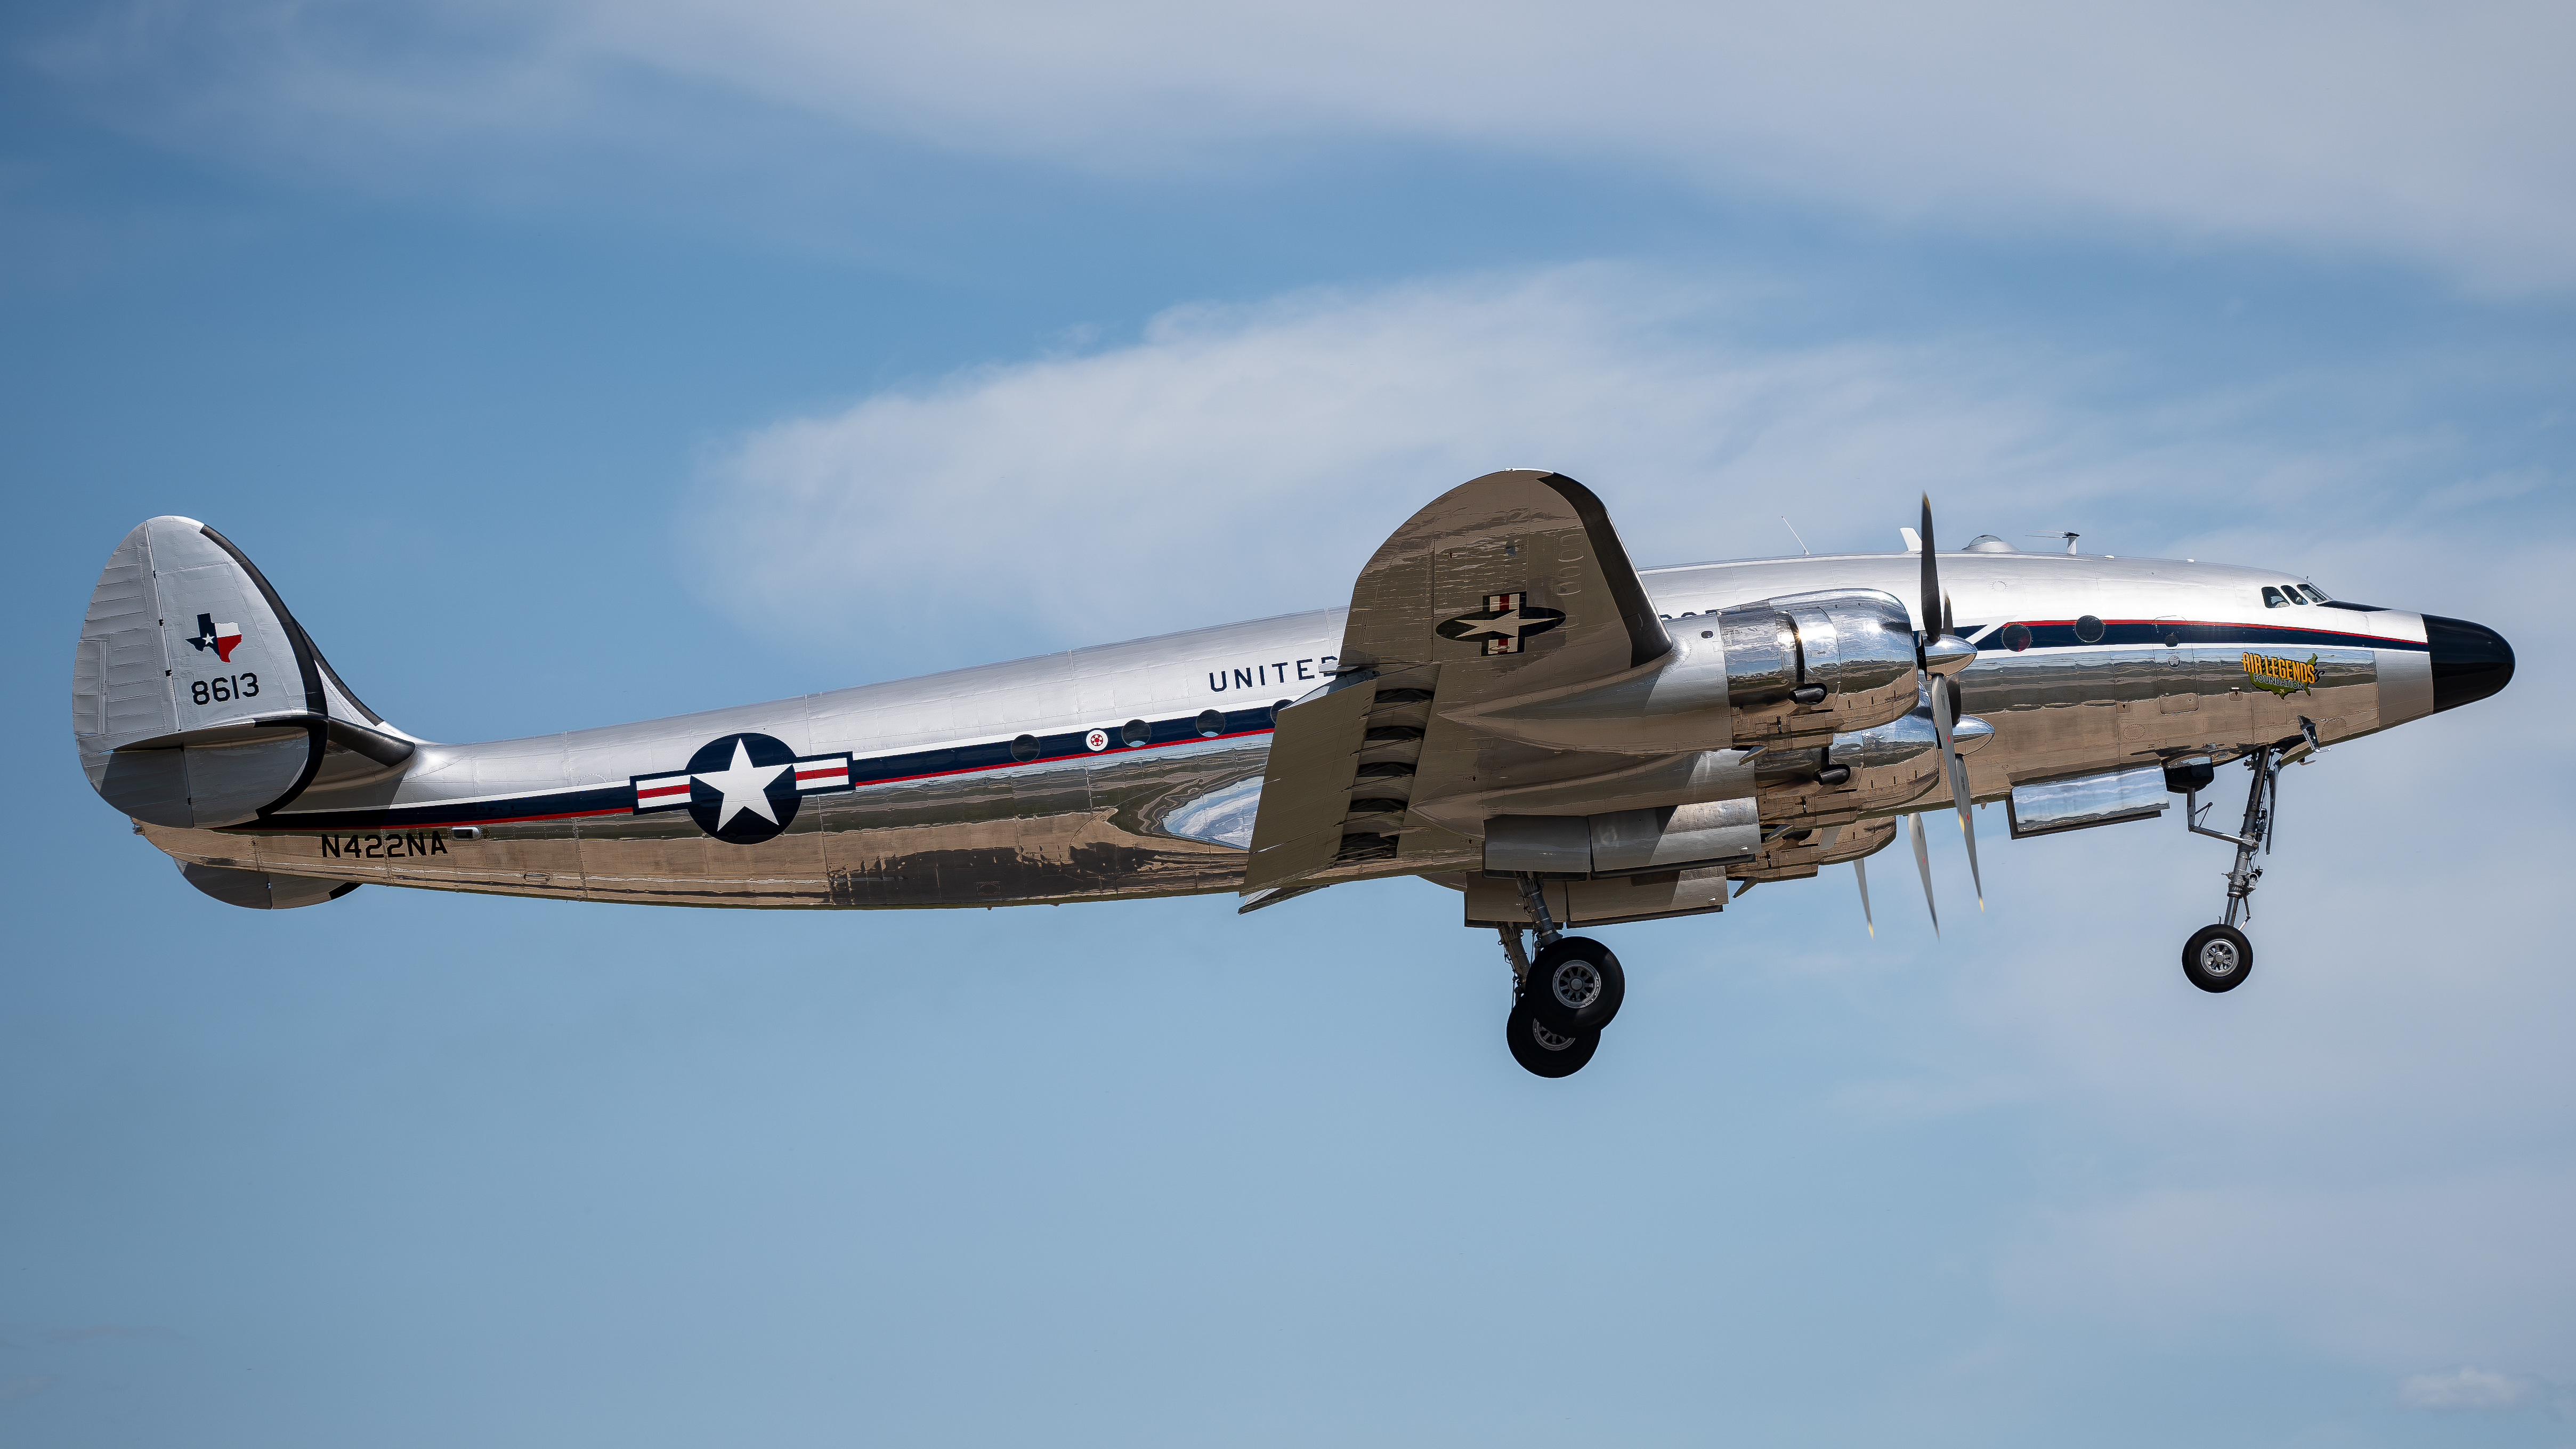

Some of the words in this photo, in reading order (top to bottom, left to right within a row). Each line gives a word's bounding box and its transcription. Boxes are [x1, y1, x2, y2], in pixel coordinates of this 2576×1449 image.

[2241, 652, 2263, 675] AIR
[2264, 655, 2315, 684] LEGENDS
[2253, 673, 2305, 691] FOUNDATION
[190, 672, 260, 706] 8613
[321, 830, 449, 859] N422NA
